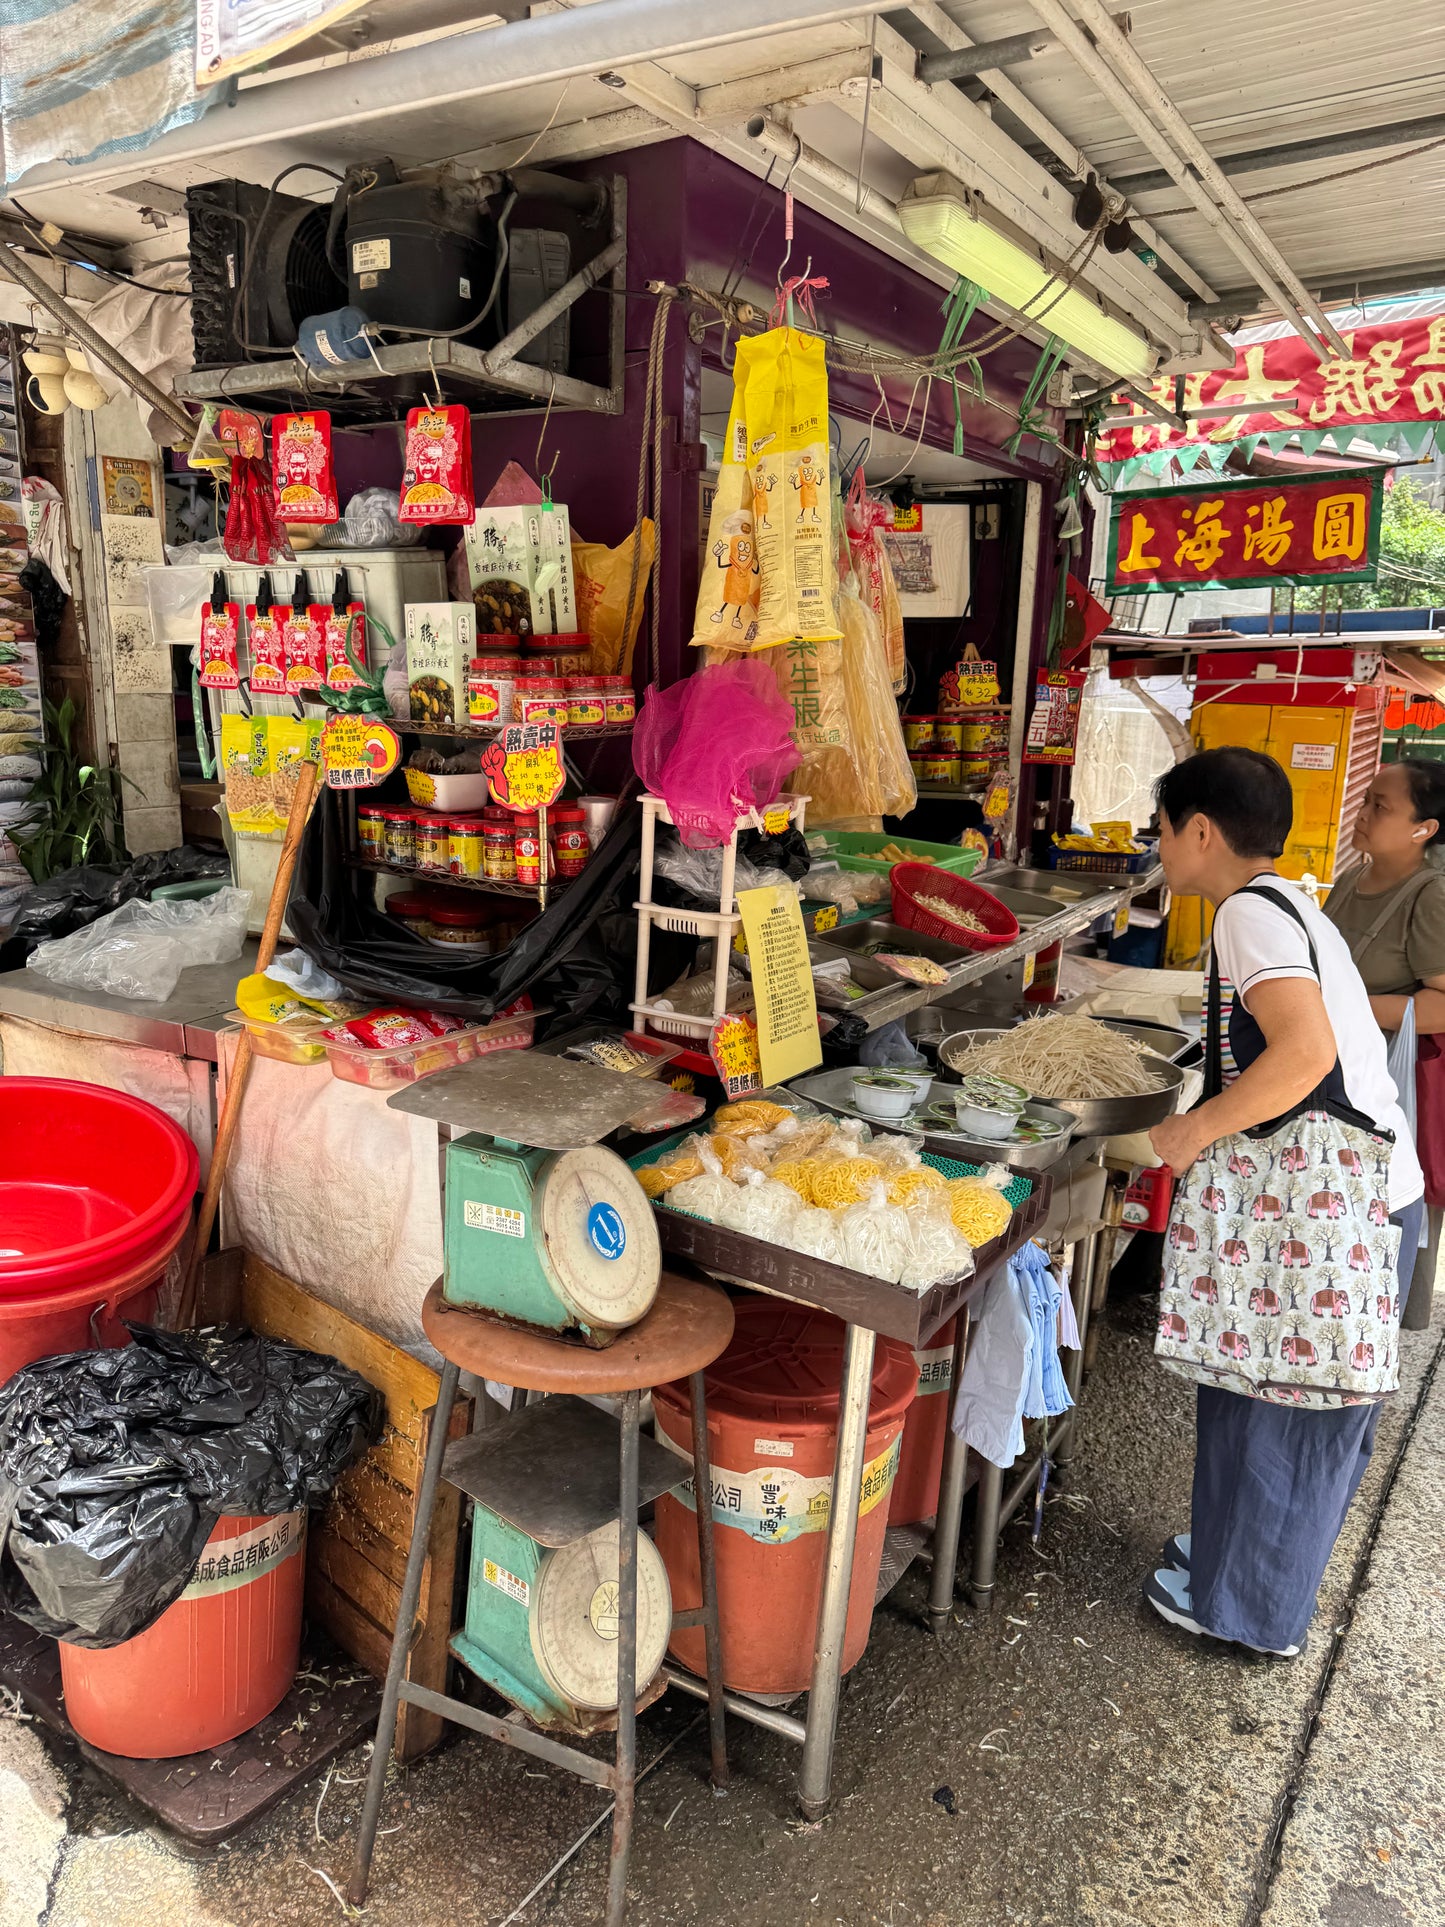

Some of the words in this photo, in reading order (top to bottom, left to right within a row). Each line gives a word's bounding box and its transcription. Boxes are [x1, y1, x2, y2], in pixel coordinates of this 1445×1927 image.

[1119, 494, 1366, 573] 上海湯圓
[959, 662, 995, 676] 熱賣中
[506, 723, 556, 752] 熱賣中
